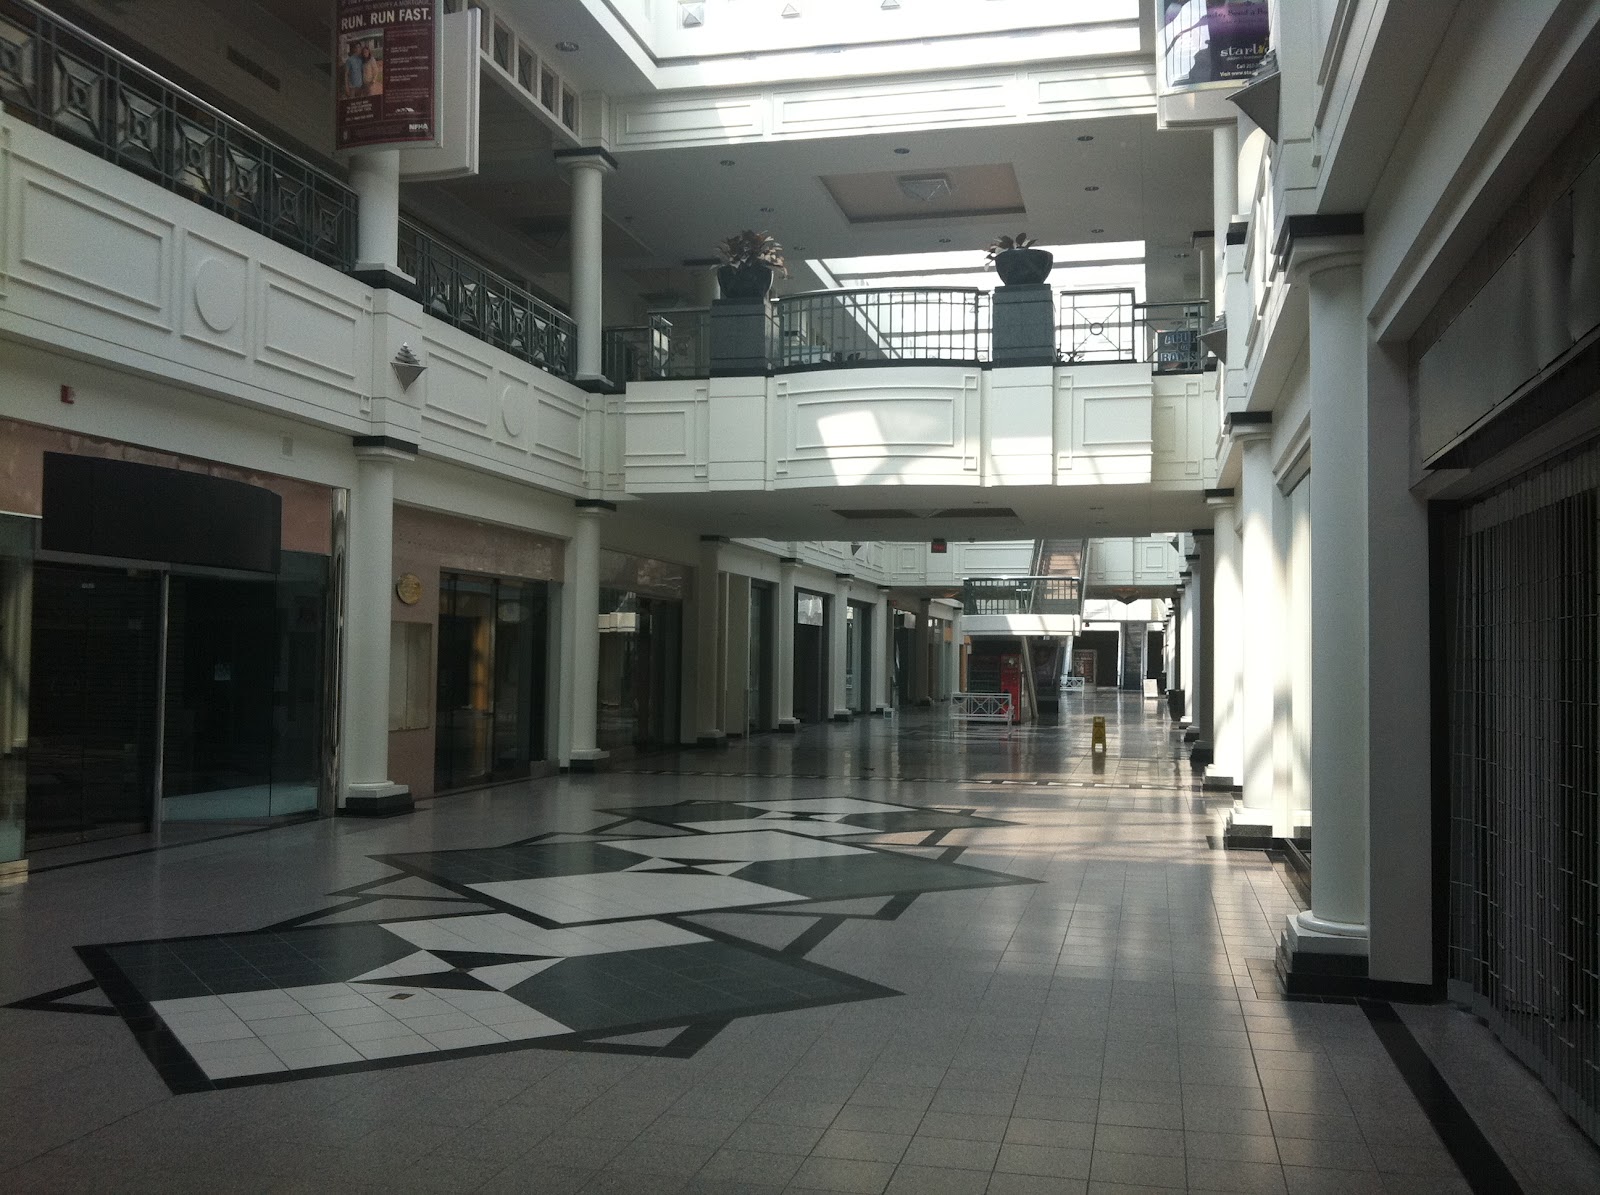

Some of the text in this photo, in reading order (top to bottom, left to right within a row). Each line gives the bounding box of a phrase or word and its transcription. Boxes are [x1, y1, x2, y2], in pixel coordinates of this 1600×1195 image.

[341, 14, 367, 31] RUN.
[370, 10, 395, 25] RUN
[399, 7, 432, 22] FAST.
